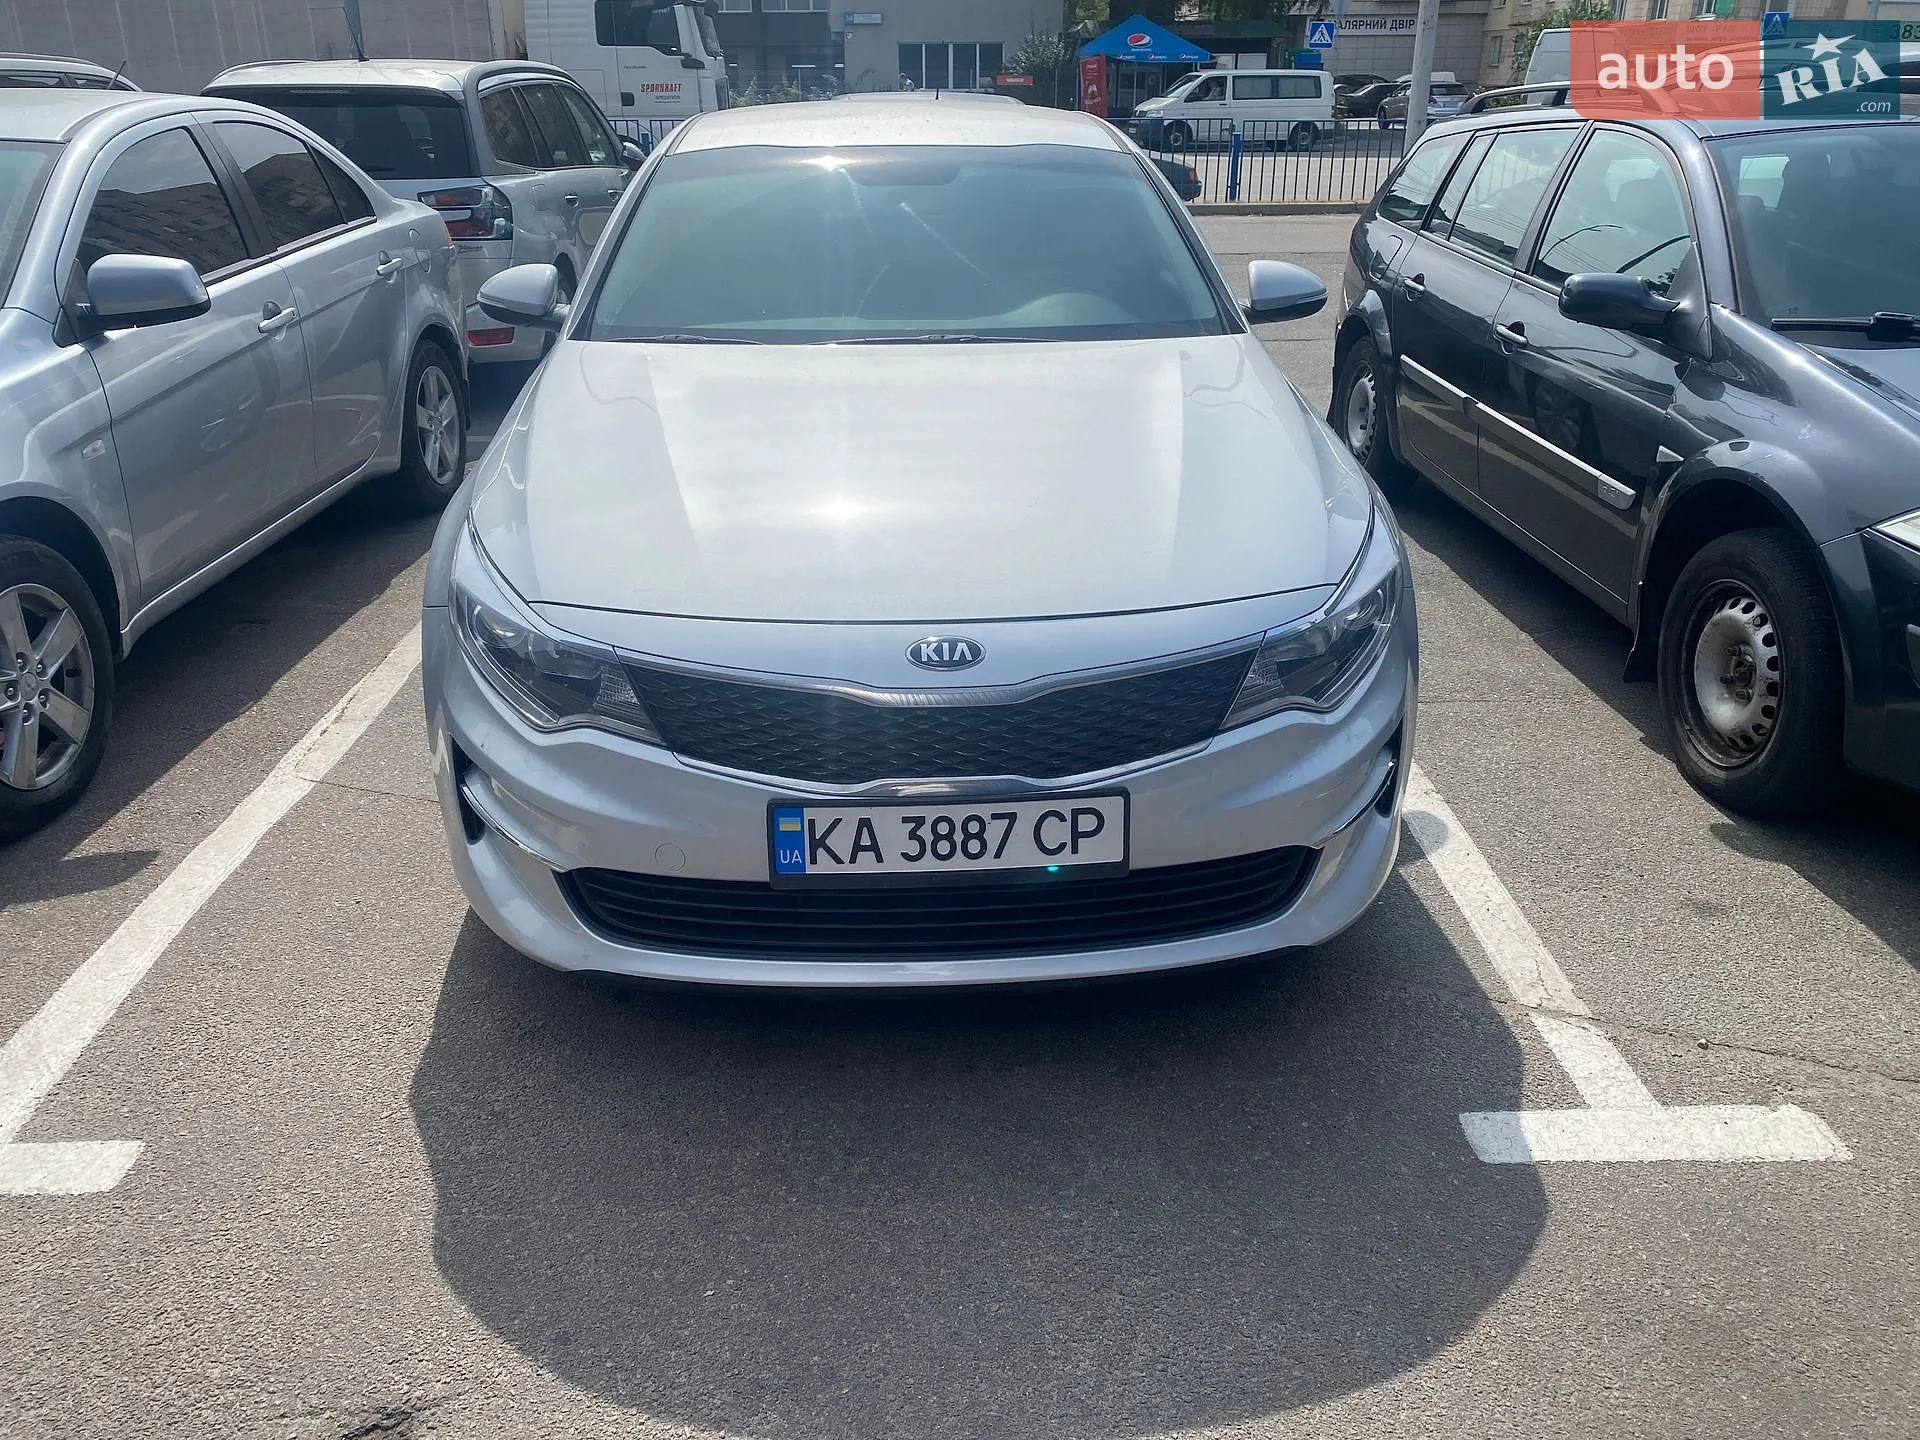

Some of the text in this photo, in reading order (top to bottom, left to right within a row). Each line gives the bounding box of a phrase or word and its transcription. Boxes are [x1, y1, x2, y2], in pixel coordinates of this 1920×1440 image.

[1328, 17, 1415, 31] АЛЯРНИЙ ДВІР
[919, 641, 973, 662] KIA
[807, 806, 1106, 865] KA 3887 CP
[779, 849, 802, 865] UA
